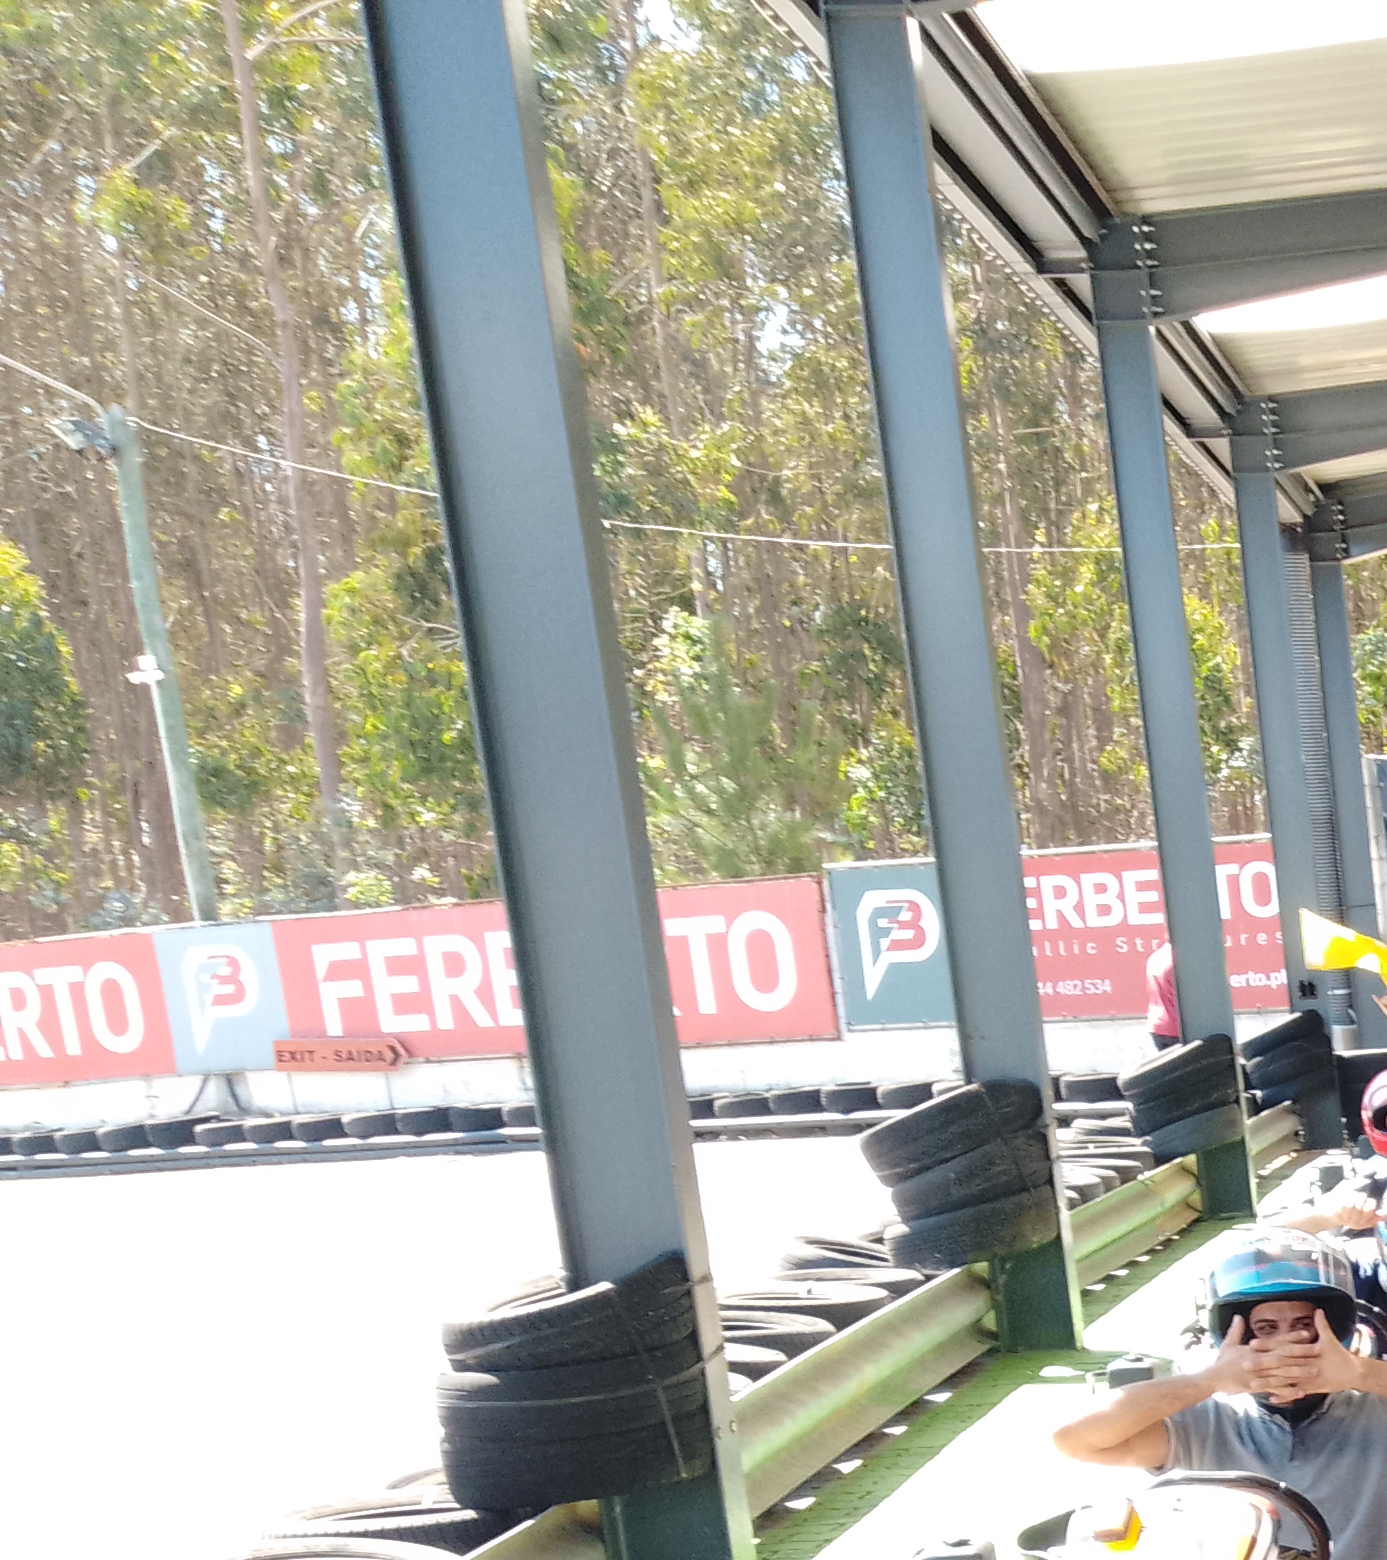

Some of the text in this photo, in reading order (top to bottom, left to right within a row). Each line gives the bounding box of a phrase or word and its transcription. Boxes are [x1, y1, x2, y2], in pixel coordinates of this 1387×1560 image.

[1022, 860, 1280, 931] ERBETO
[0, 960, 145, 1061] RTO
[311, 910, 799, 1037] FERBTO
[276, 1049, 315, 1064] EXIT
